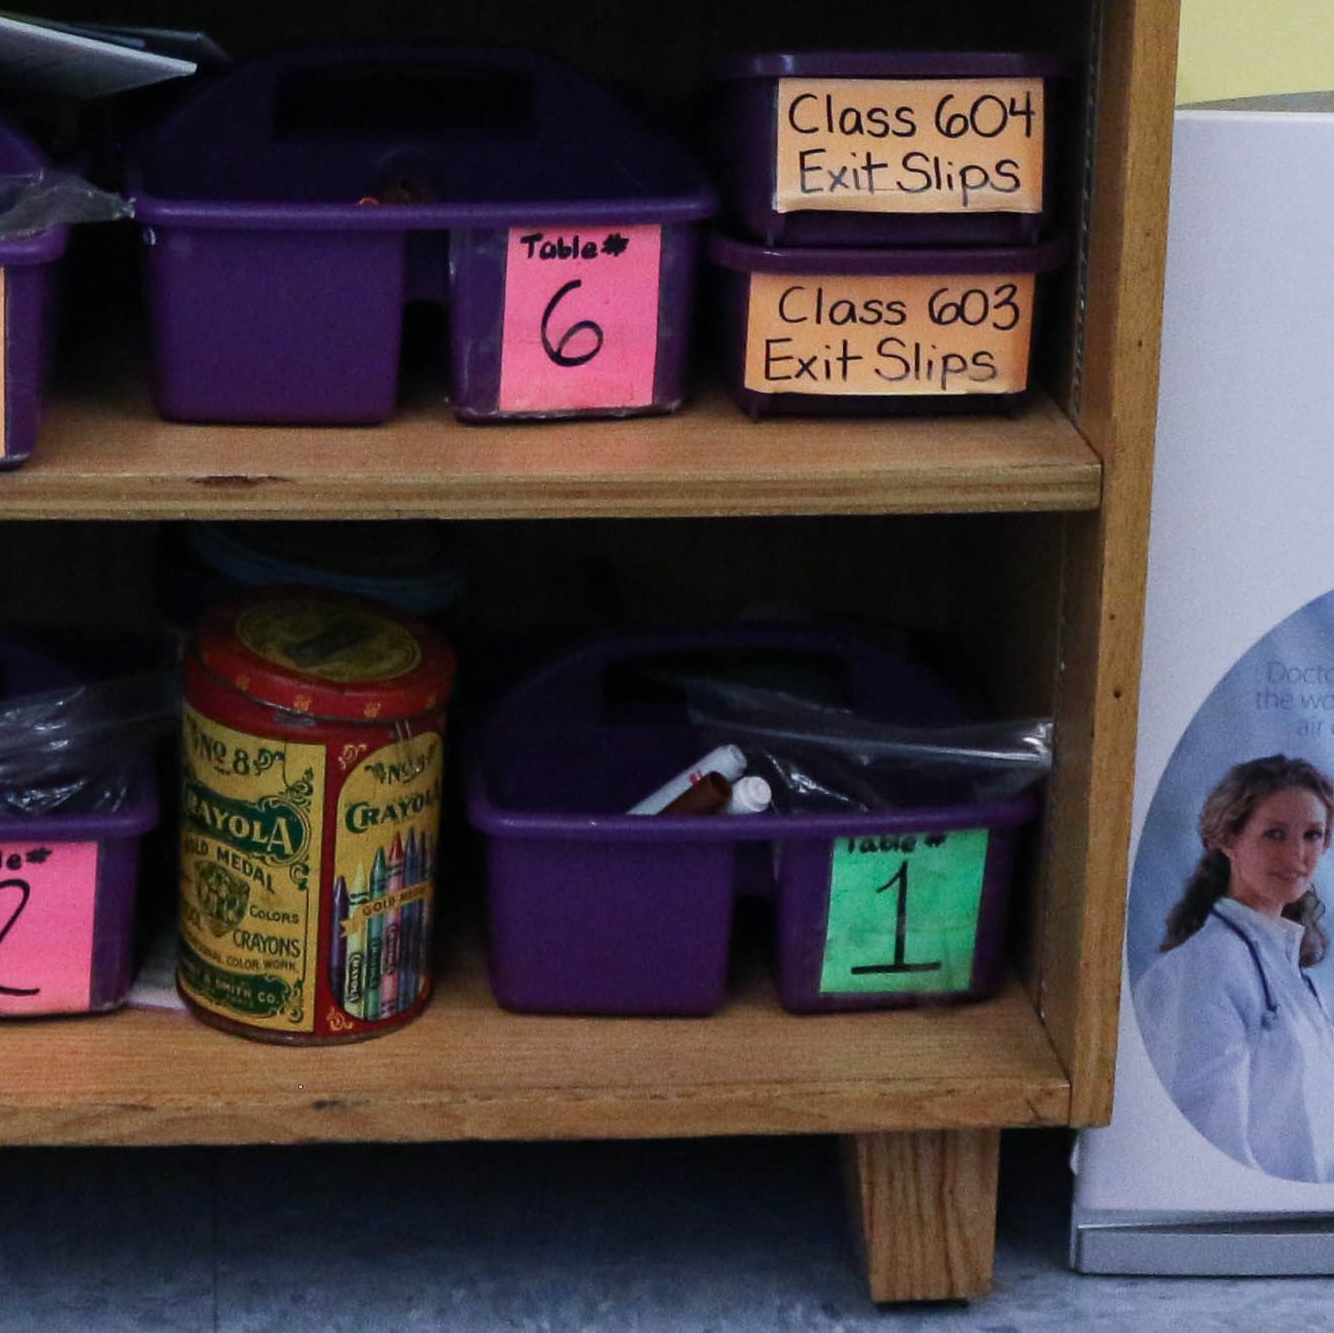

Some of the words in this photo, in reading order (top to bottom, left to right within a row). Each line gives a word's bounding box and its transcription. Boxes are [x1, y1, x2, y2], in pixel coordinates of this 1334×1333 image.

[788, 93, 917, 139] Class
[934, 91, 1036, 139] 604
[799, 149, 889, 195] Exit
[896, 151, 1021, 208] Slips
[520, 234, 599, 261] Table
[541, 279, 604, 368] 6
[778, 285, 907, 326] Class
[927, 283, 1020, 331] 603
[764, 338, 862, 382] Exit
[875, 337, 998, 391] Slips
[1256, 690, 1292, 711] the
[1296, 719, 1322, 738] air
[233, 749, 250, 776] 8
[218, 845, 276, 895] MEDAL
[250, 904, 299, 924] COLORS
[851, 860, 942, 975] 1
[233, 929, 302, 958] CRAYONS
